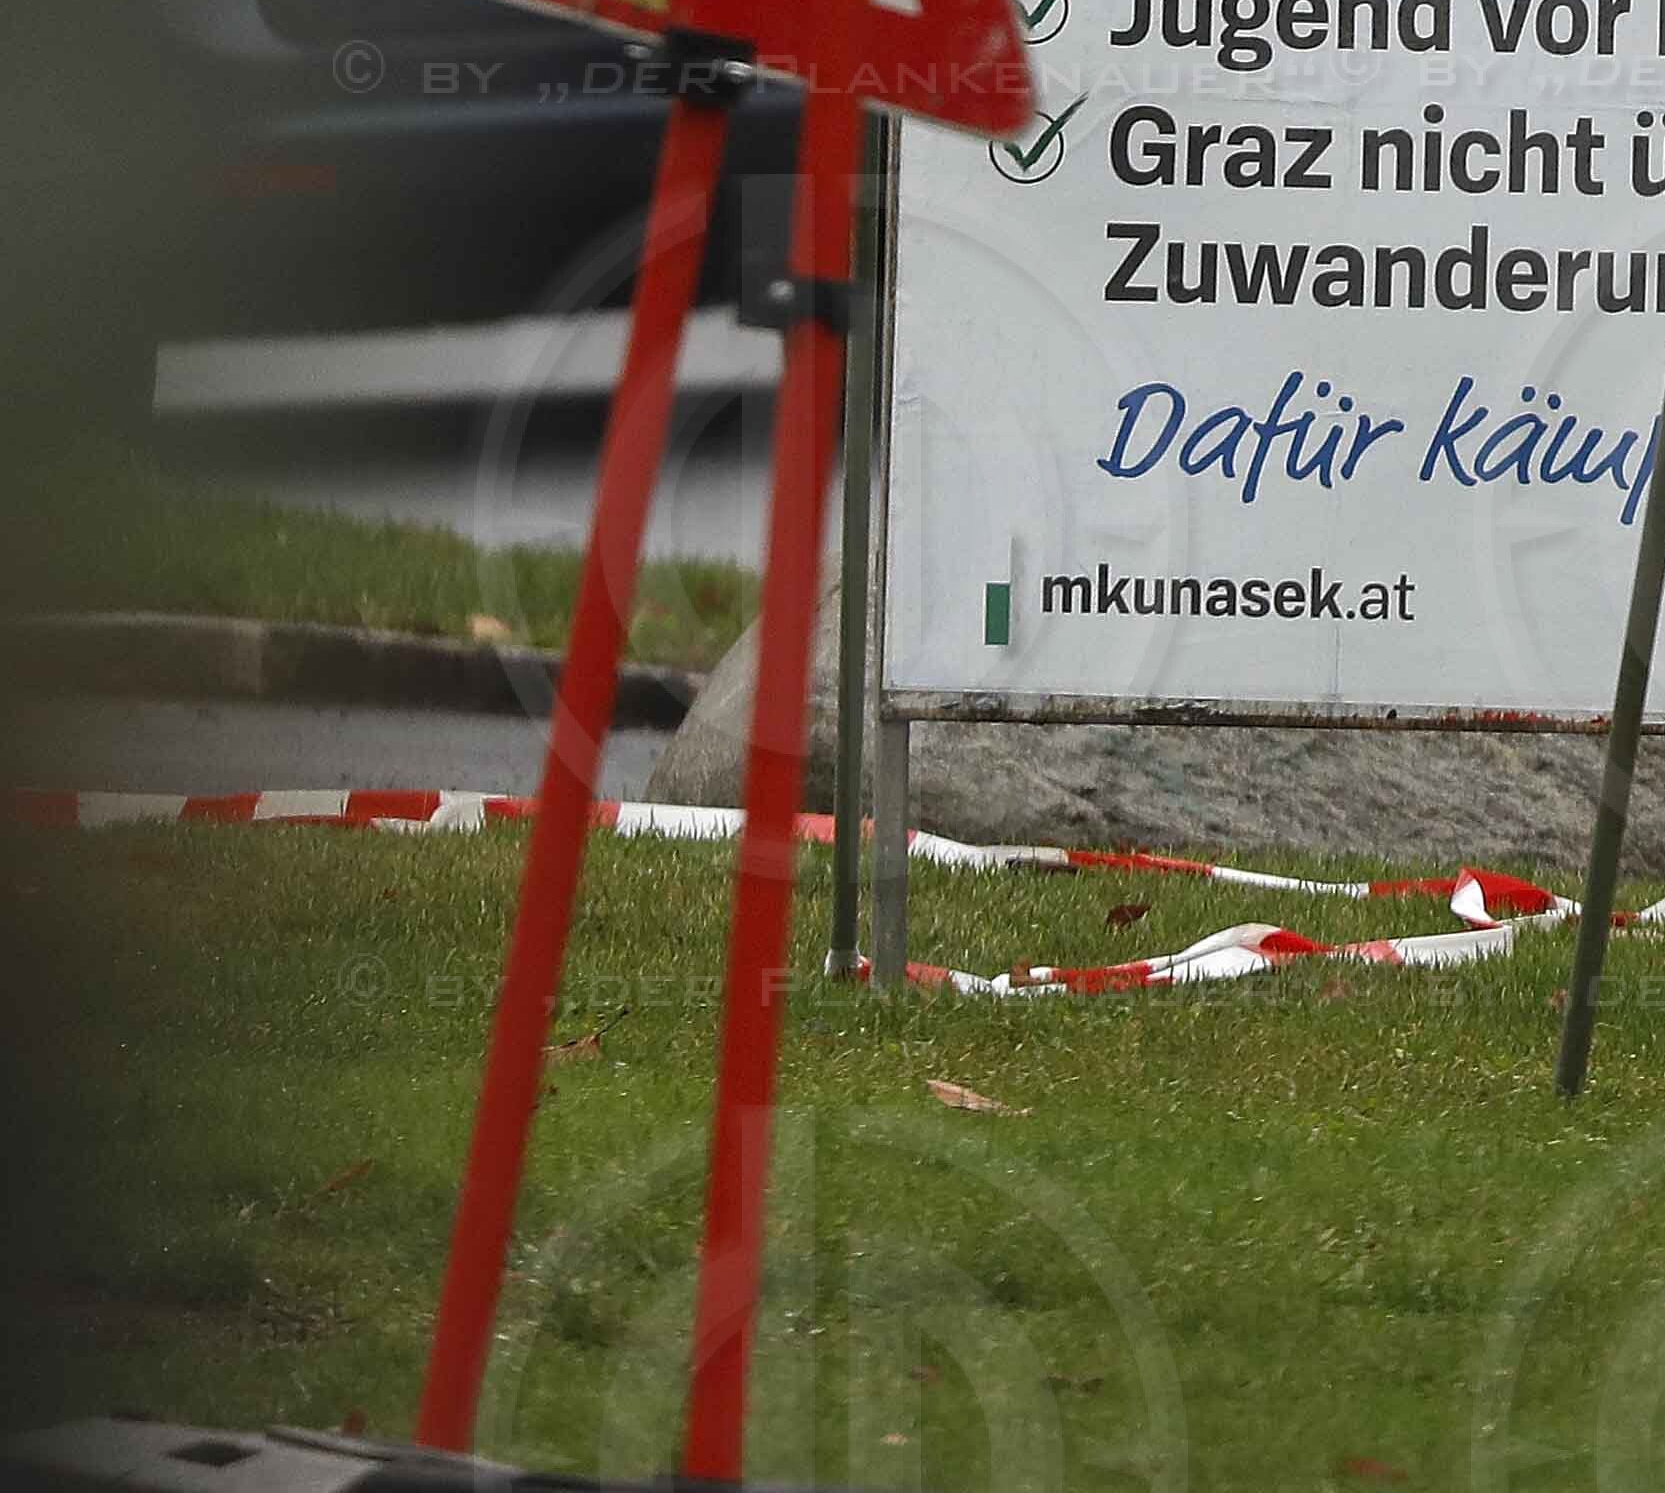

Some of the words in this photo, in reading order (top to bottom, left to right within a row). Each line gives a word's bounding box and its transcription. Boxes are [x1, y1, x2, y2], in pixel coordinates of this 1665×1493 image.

[1109, 105, 1333, 190] Graz
[1361, 104, 1605, 197] nicht
[1096, 370, 1405, 504] Dafür
[1040, 562, 1416, 623] mkunasek.at
